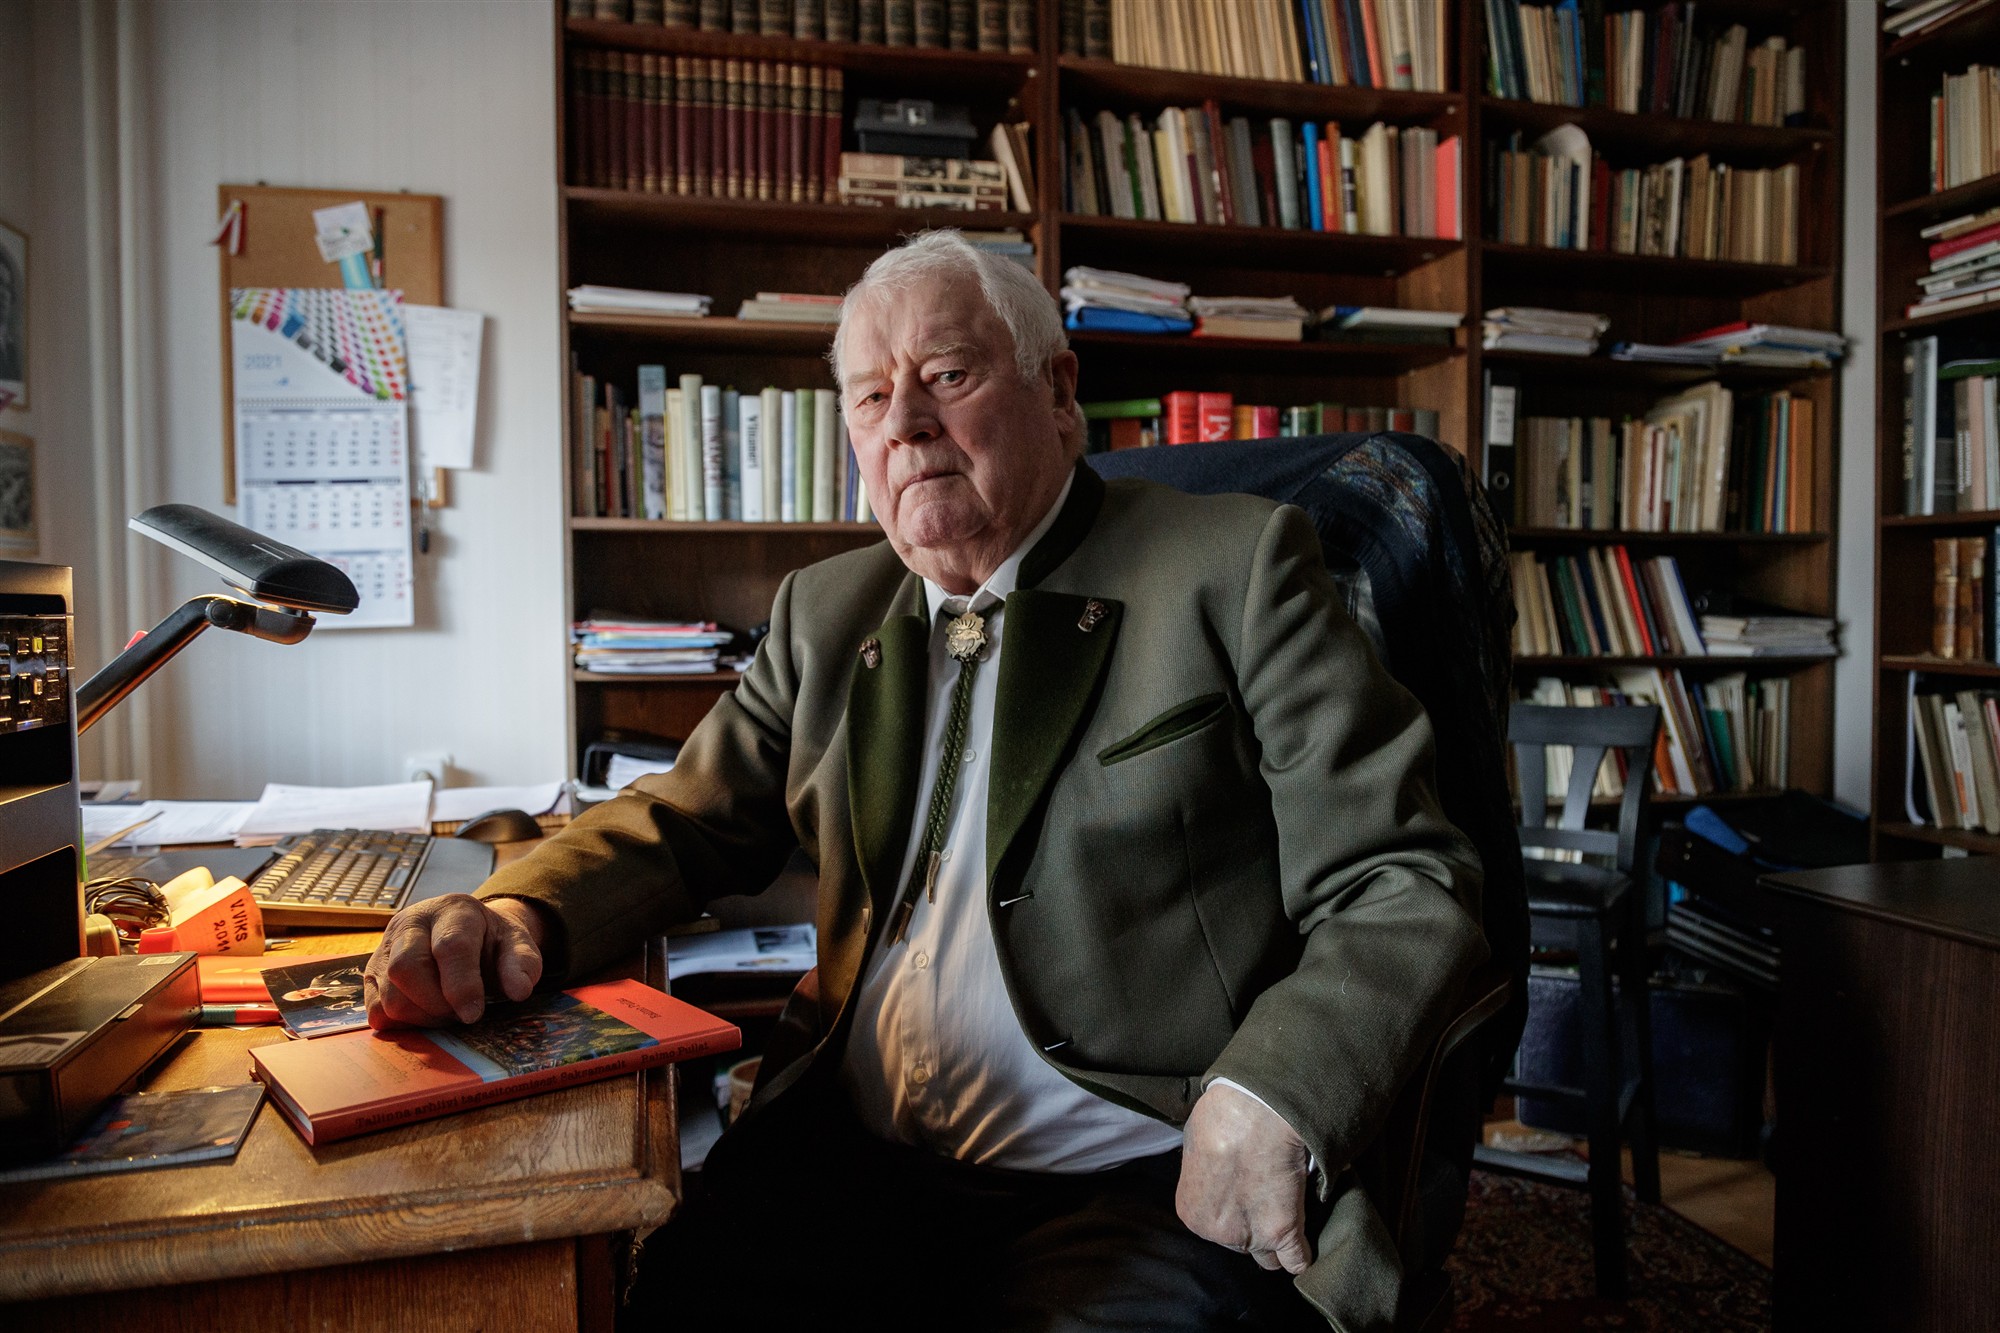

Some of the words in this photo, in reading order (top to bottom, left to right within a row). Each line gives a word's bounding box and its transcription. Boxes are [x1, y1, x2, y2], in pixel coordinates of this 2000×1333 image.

[245, 354, 282, 369] 2021
[213, 919, 231, 952] 2011
[641, 1050, 676, 1064] Raimo
[356, 1109, 412, 1129] Tallinna
[415, 1099, 459, 1117] arhiivi
